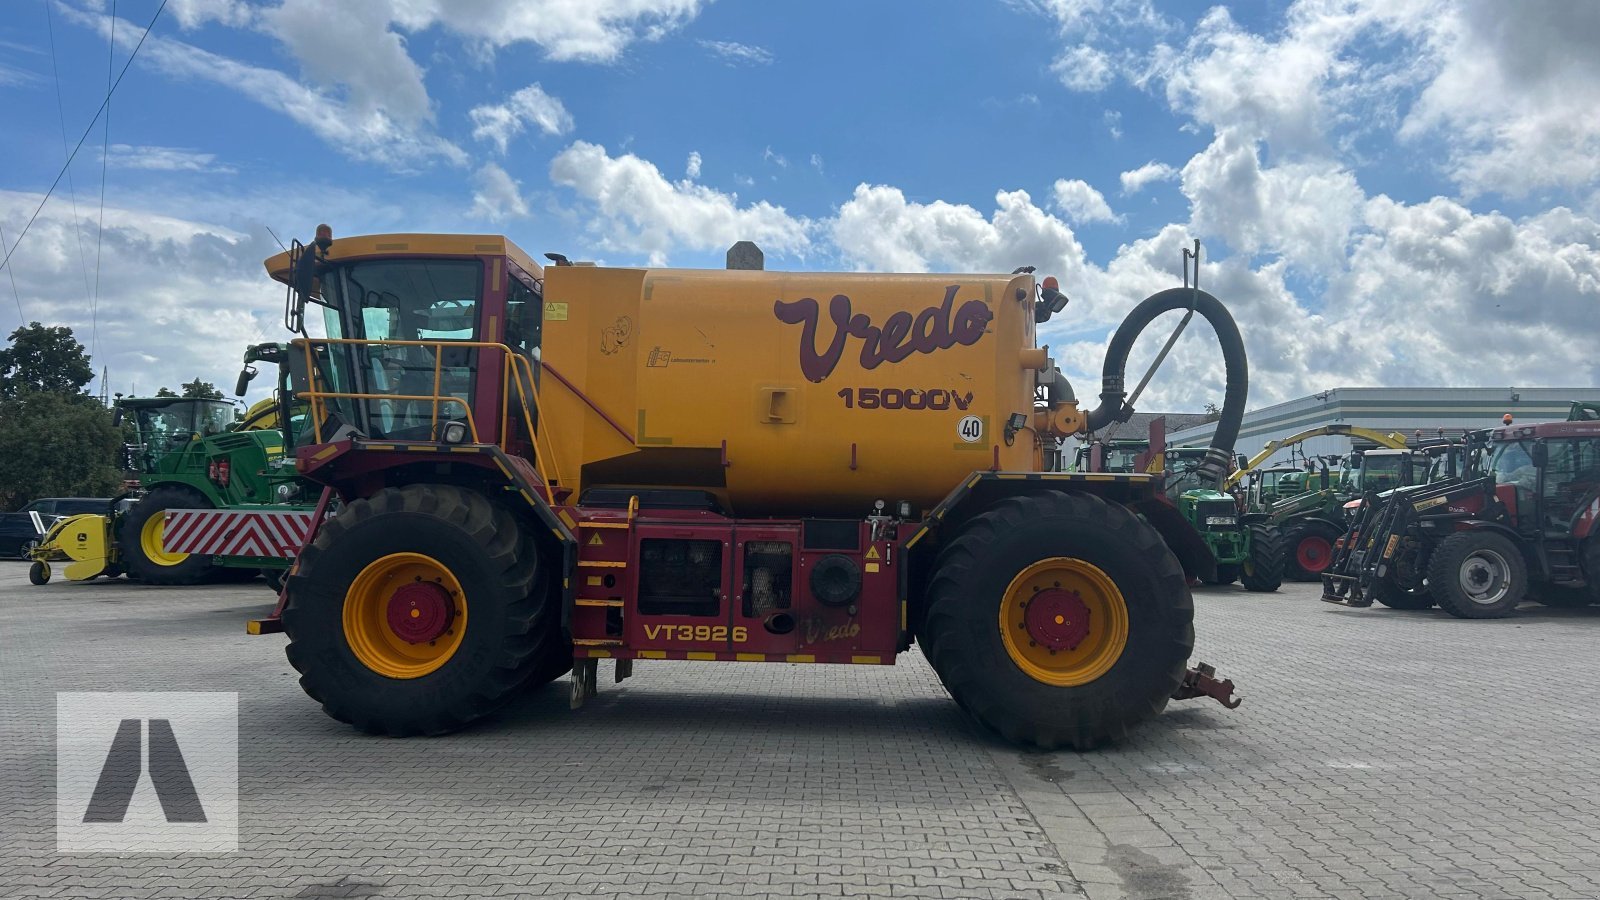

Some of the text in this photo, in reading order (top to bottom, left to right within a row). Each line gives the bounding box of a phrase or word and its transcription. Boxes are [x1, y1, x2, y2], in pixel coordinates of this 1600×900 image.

[774, 285, 994, 383] Vredo
[838, 387, 974, 411] 15000V
[962, 420, 980, 437] 40
[643, 624, 748, 642] VT3926
